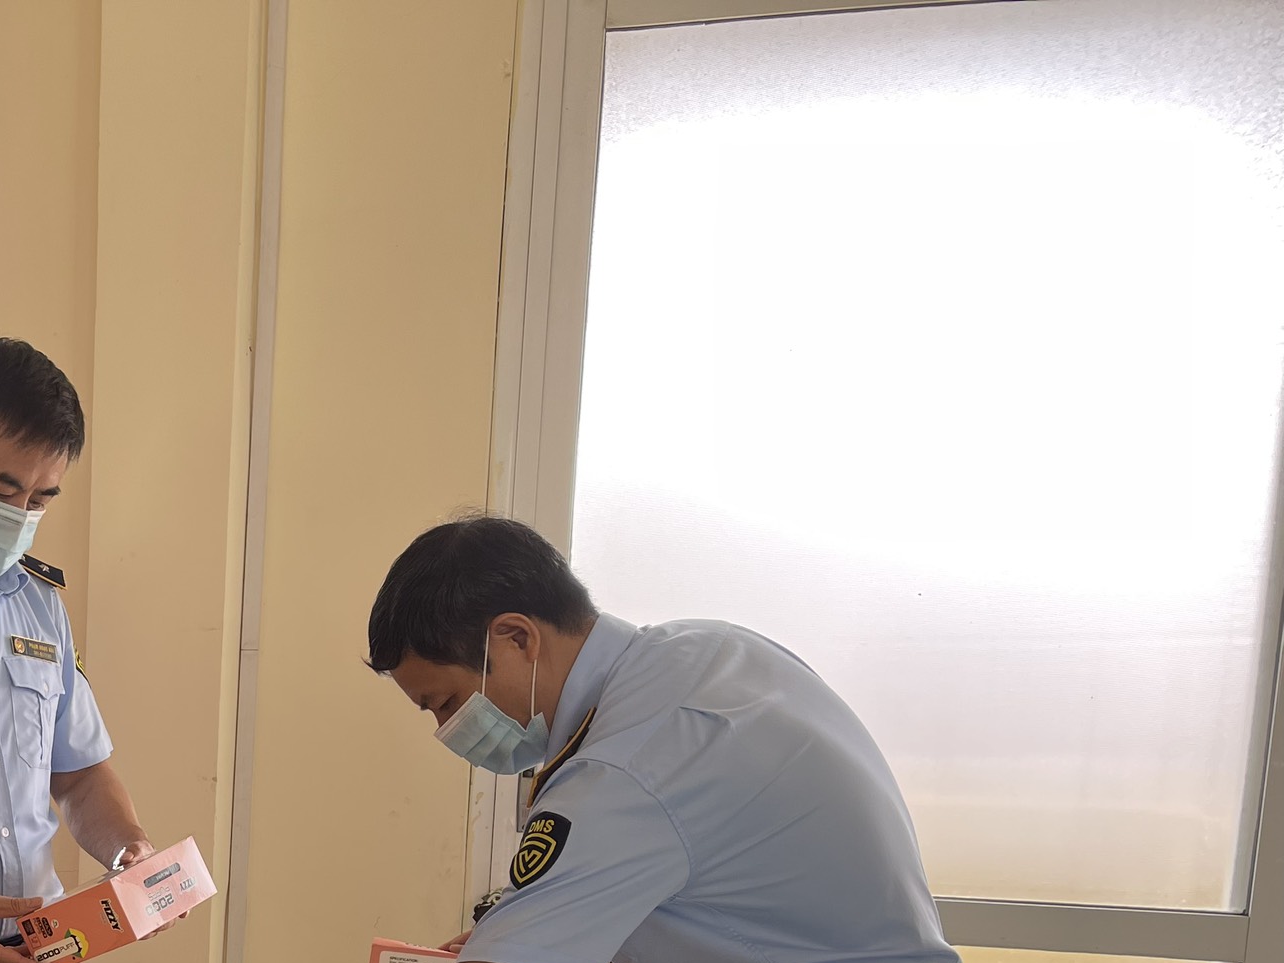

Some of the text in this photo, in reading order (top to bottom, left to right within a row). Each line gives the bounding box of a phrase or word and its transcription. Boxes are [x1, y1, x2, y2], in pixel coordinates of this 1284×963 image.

[529, 819, 554, 833] DMS
[100, 898, 123, 931] FIZZY
[36, 947, 61, 962] 2000
